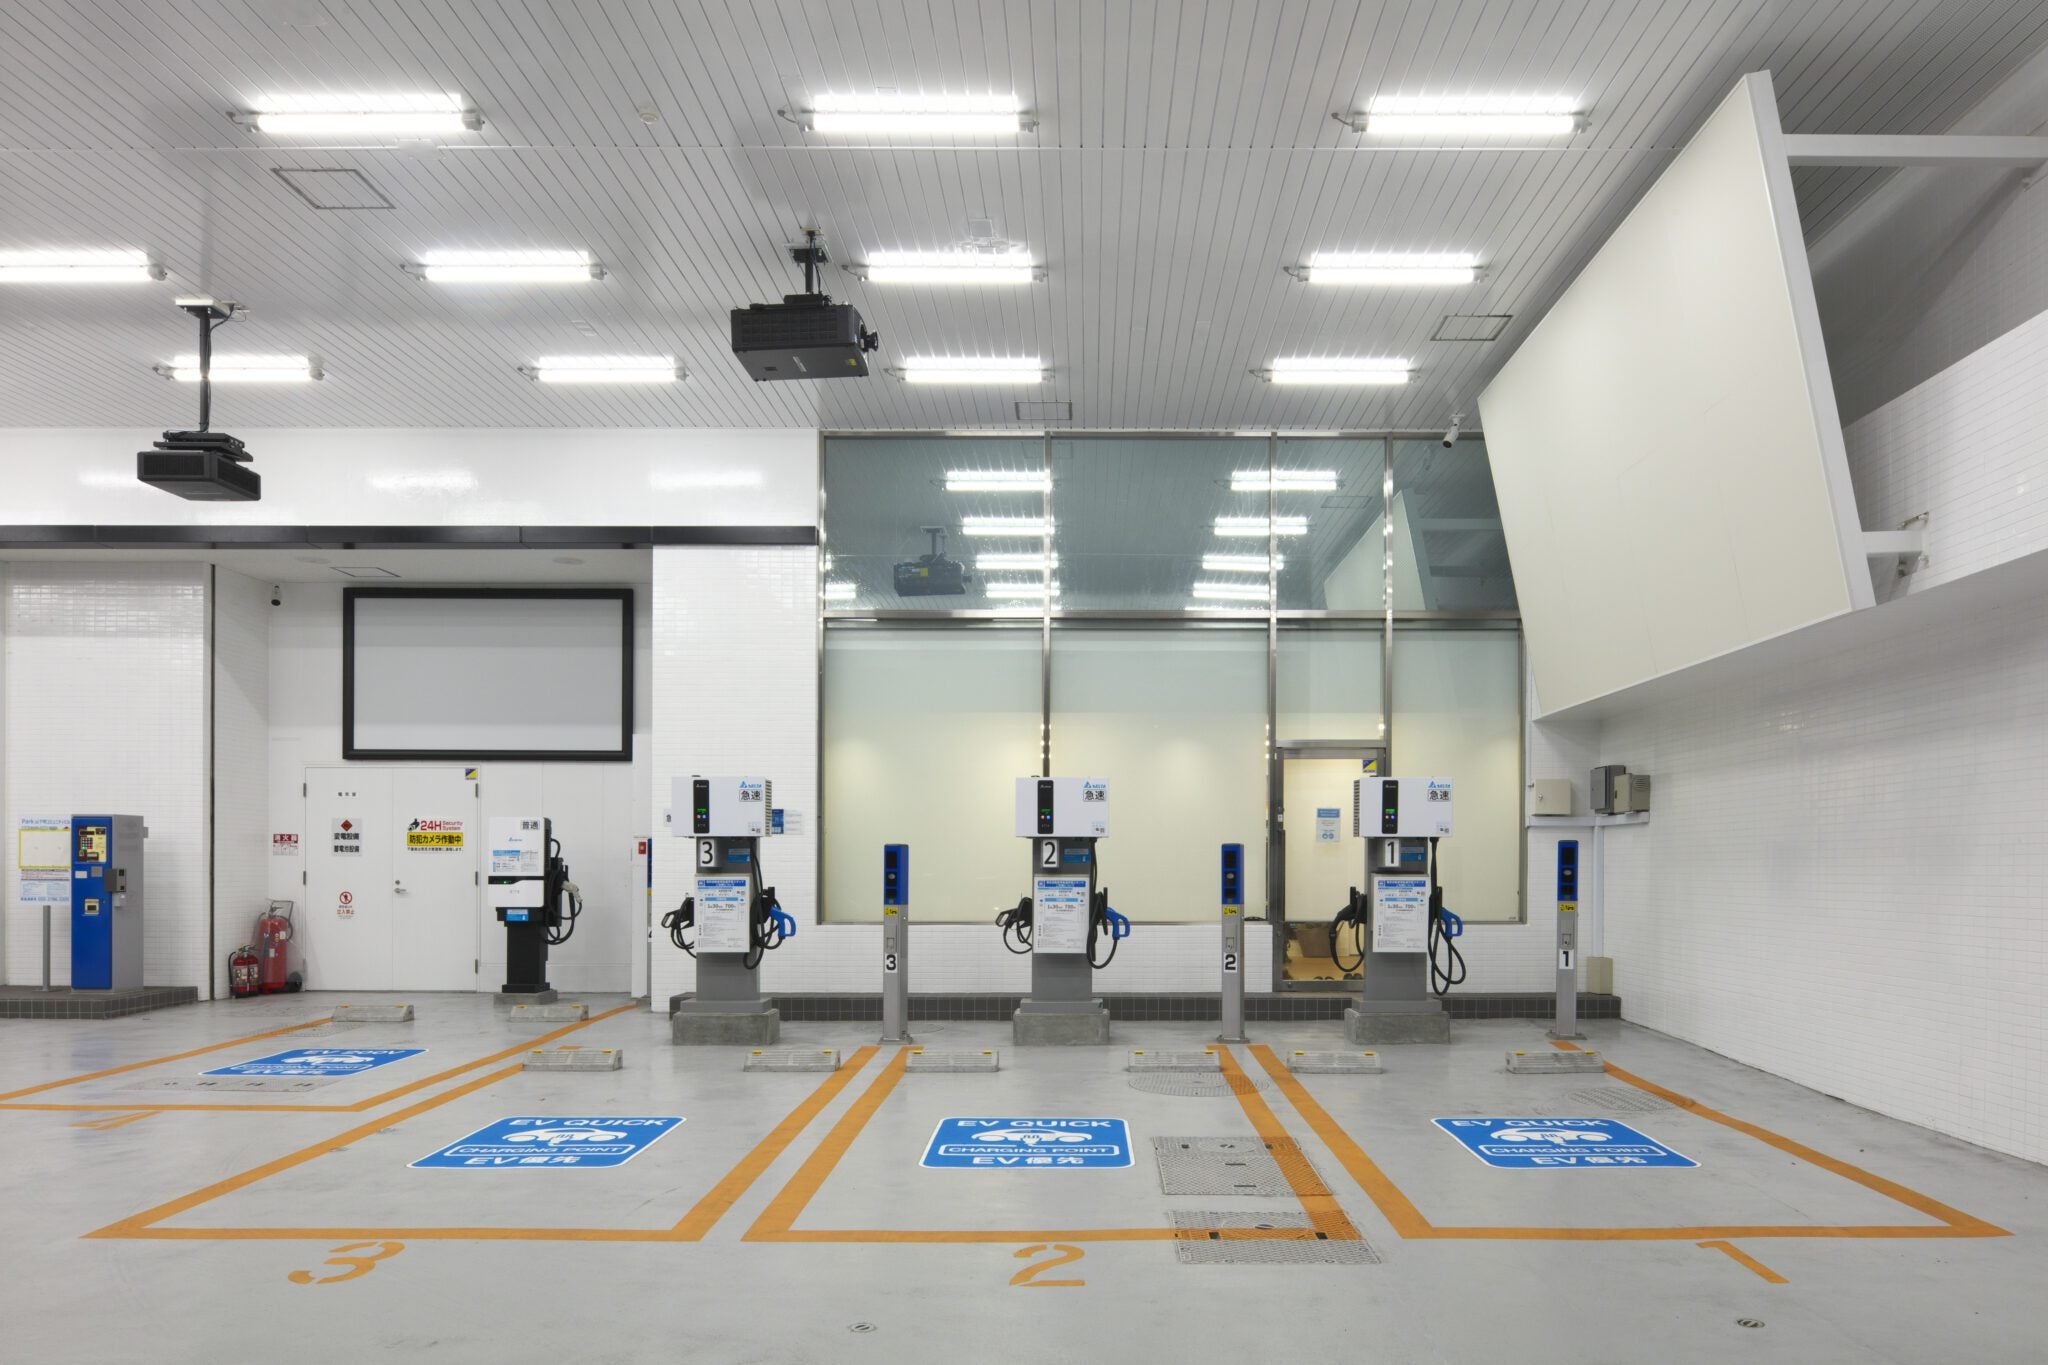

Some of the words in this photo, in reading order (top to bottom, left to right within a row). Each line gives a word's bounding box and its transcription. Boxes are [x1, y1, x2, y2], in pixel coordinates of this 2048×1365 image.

[740, 790, 760, 800] 急速
[1084, 790, 1104, 800] 急速
[1429, 790, 1449, 800] 急速
[420, 820, 442, 830] 24H
[409, 834, 462, 844] 防犯カメラ作動中
[702, 841, 713, 864] 3
[1044, 841, 1056, 864] 2
[1387, 841, 1395, 864] 1
[886, 954, 897, 971] 3
[1225, 954, 1236, 971] 2
[1562, 951, 1569, 967] 1
[1503, 1119, 1609, 1127] QUICK
[287, 1241, 406, 1285] 3
[1008, 1243, 1086, 1287] 2
[1695, 1240, 1791, 1284] 1
